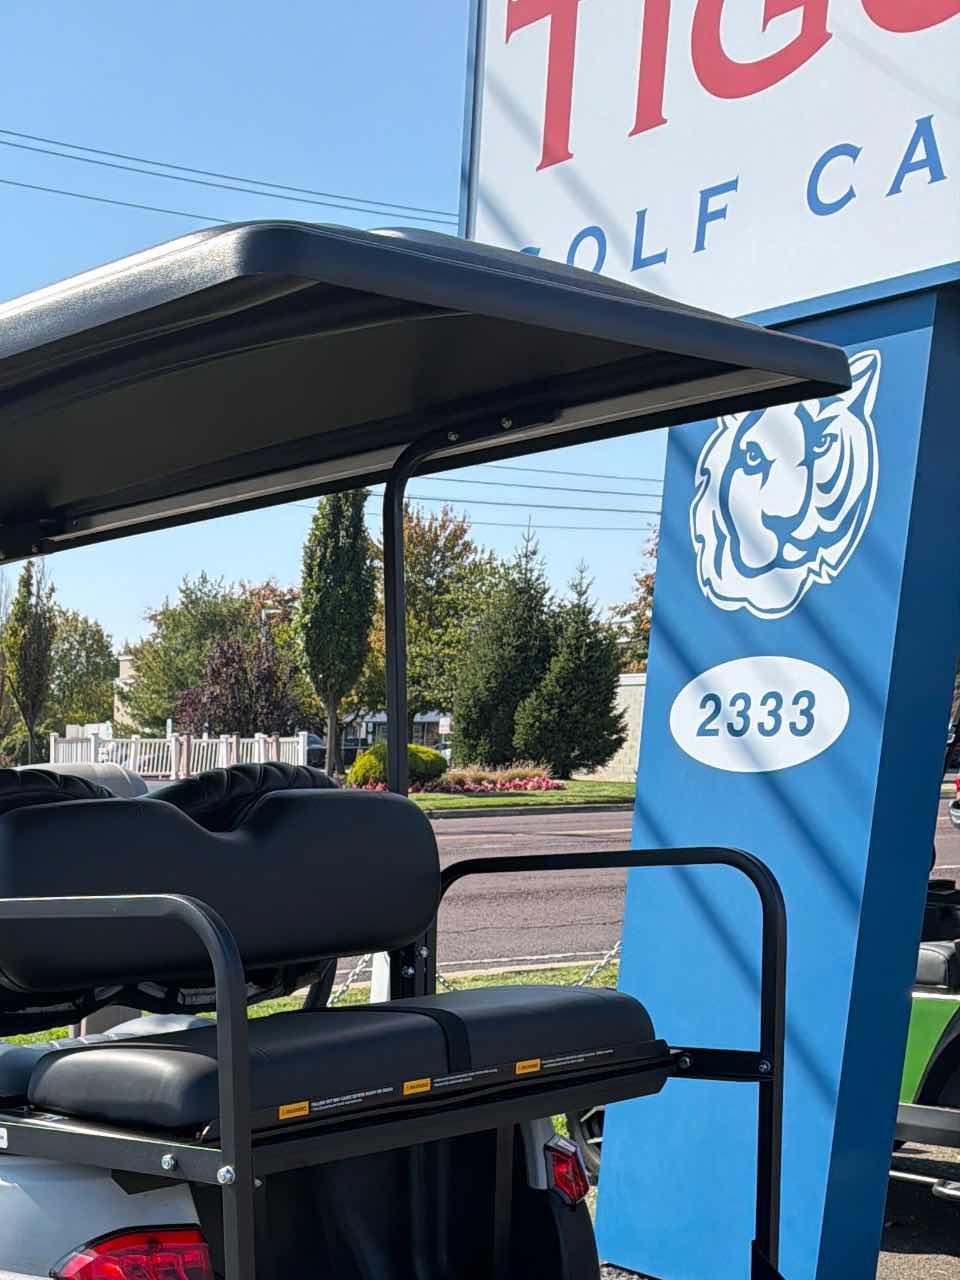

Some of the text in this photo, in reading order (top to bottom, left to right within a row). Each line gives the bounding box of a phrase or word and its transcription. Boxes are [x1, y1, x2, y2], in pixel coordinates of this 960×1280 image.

[505, 0, 960, 172] TIG
[520, 175, 740, 273] OLF
[696, 689, 816, 738] 2333
